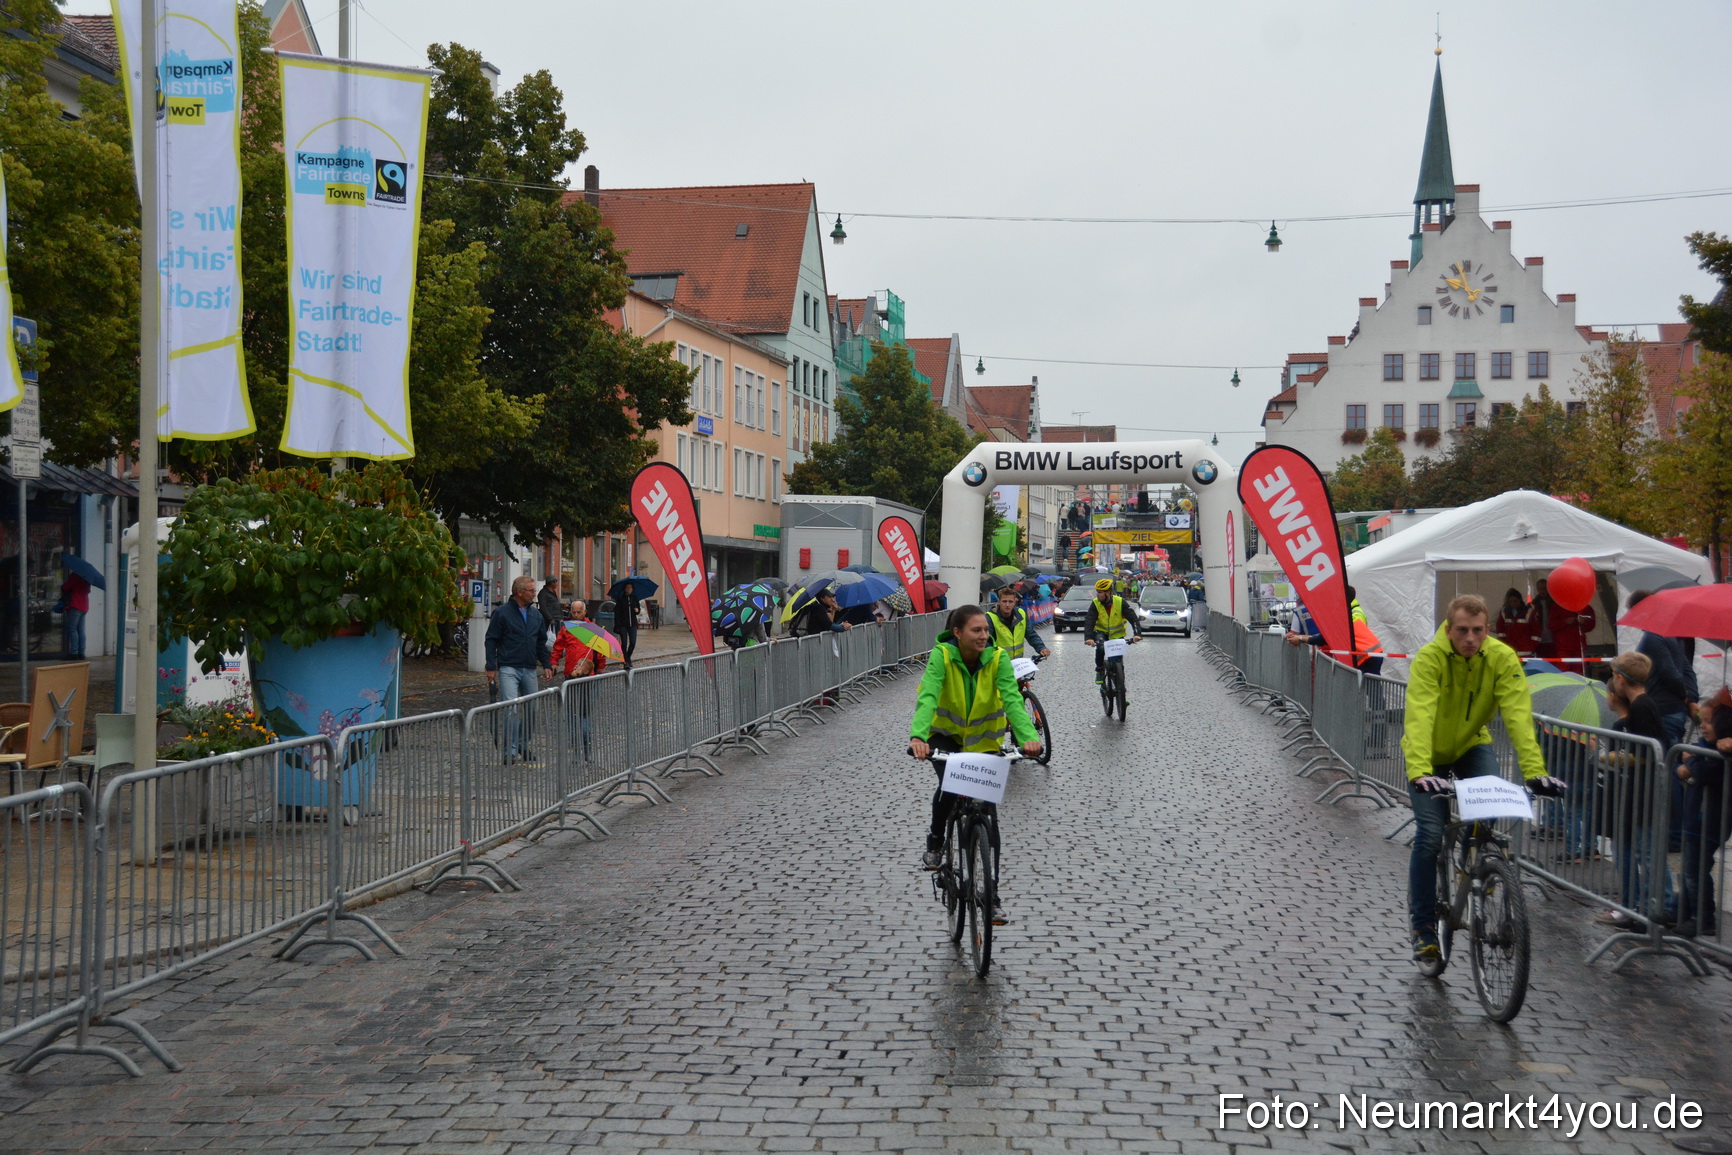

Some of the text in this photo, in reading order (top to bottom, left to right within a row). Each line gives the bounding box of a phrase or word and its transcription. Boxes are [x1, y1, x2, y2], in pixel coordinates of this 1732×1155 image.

[297, 153, 365, 168] Kampagne
[297, 166, 371, 184] Fairtrade
[327, 188, 365, 200] Towns
[376, 192, 405, 202] FAIRTRADE
[300, 266, 382, 295] Wir sind
[299, 299, 402, 326] Fairtrade-
[298, 331, 362, 352] Stadt!
[995, 451, 1184, 474] BMW Laufsport
[1131, 533, 1154, 541] ZIEL
[474, 584, 481, 595] P
[960, 762, 997, 776] Erste Frau
[950, 771, 1001, 789] Halbmarathon
[1494, 787, 1518, 795] Mann
[1465, 797, 1525, 806] Halbmarathon
